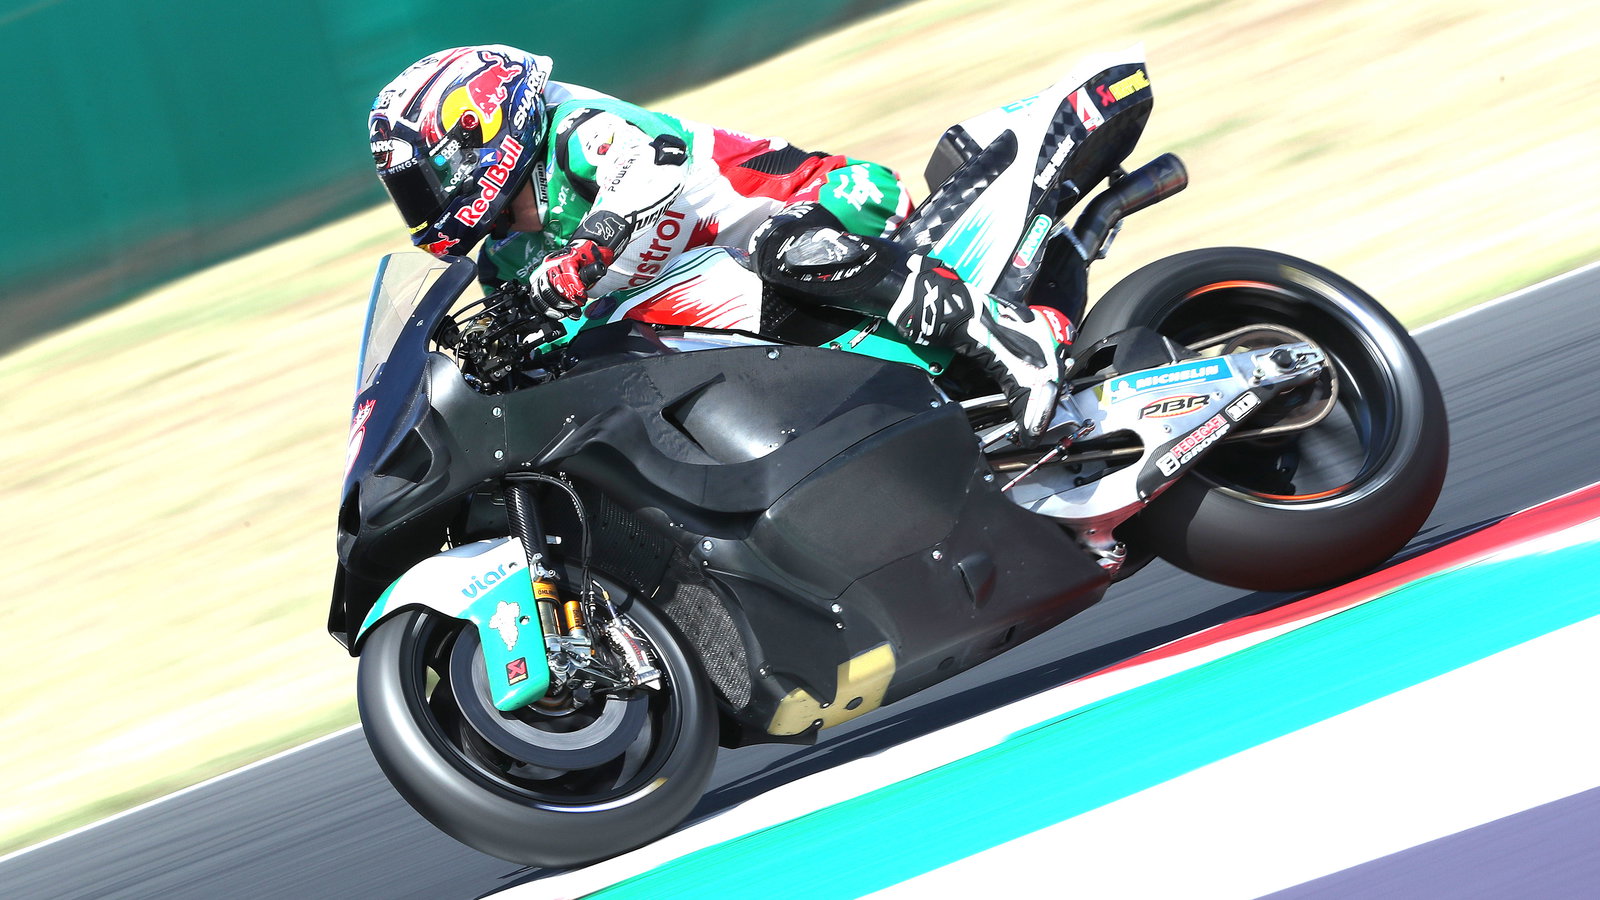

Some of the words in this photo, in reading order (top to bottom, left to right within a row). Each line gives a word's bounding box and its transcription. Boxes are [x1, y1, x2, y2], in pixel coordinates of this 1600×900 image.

[388, 157, 418, 175] WINGS
[455, 178, 500, 228] Red
[485, 134, 525, 187] Bull
[616, 209, 687, 291] astrol
[1135, 364, 1220, 390] MICHELIN
[1137, 393, 1211, 421] PBR
[1180, 423, 1231, 466] GROUP
[461, 563, 508, 600] viar
